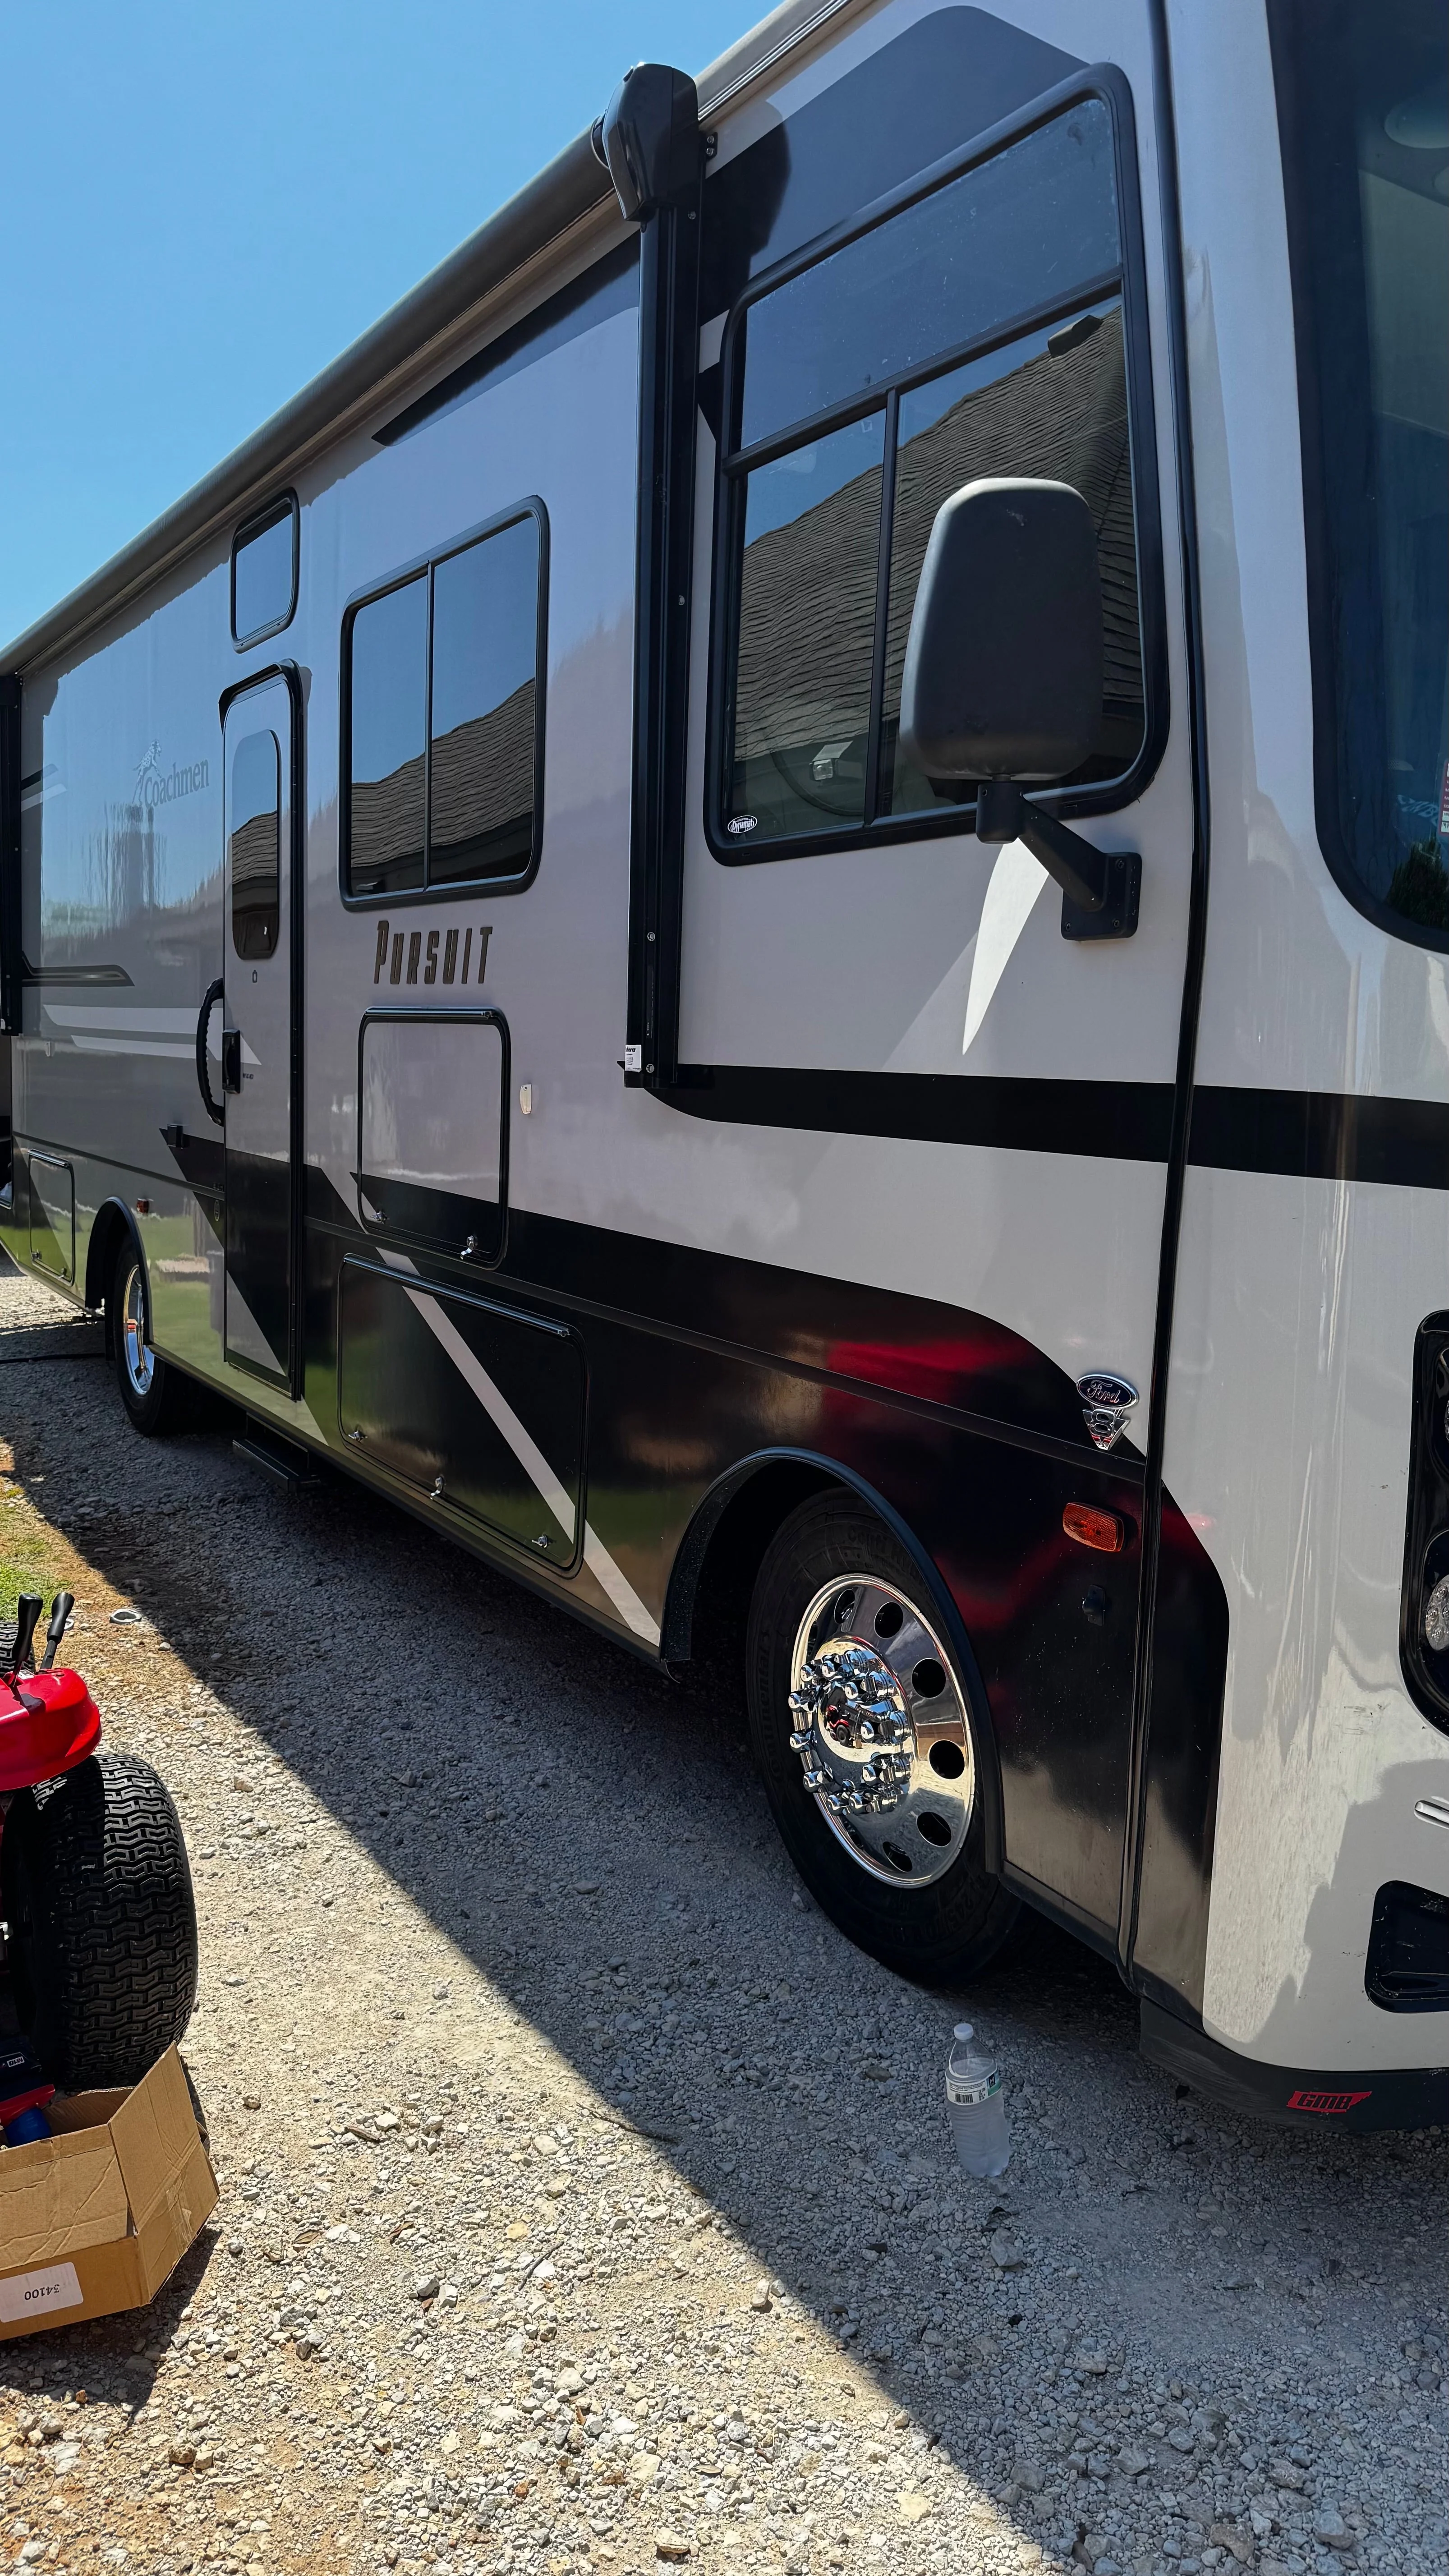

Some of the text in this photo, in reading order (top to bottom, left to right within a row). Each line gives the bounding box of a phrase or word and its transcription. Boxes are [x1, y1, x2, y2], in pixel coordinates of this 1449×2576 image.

[144, 759, 209, 809] Coachmen
[374, 920, 493, 984] PURSUIT
[1087, 1380, 1121, 1403] Ford
[24, 2284, 60, 2300] 34100
